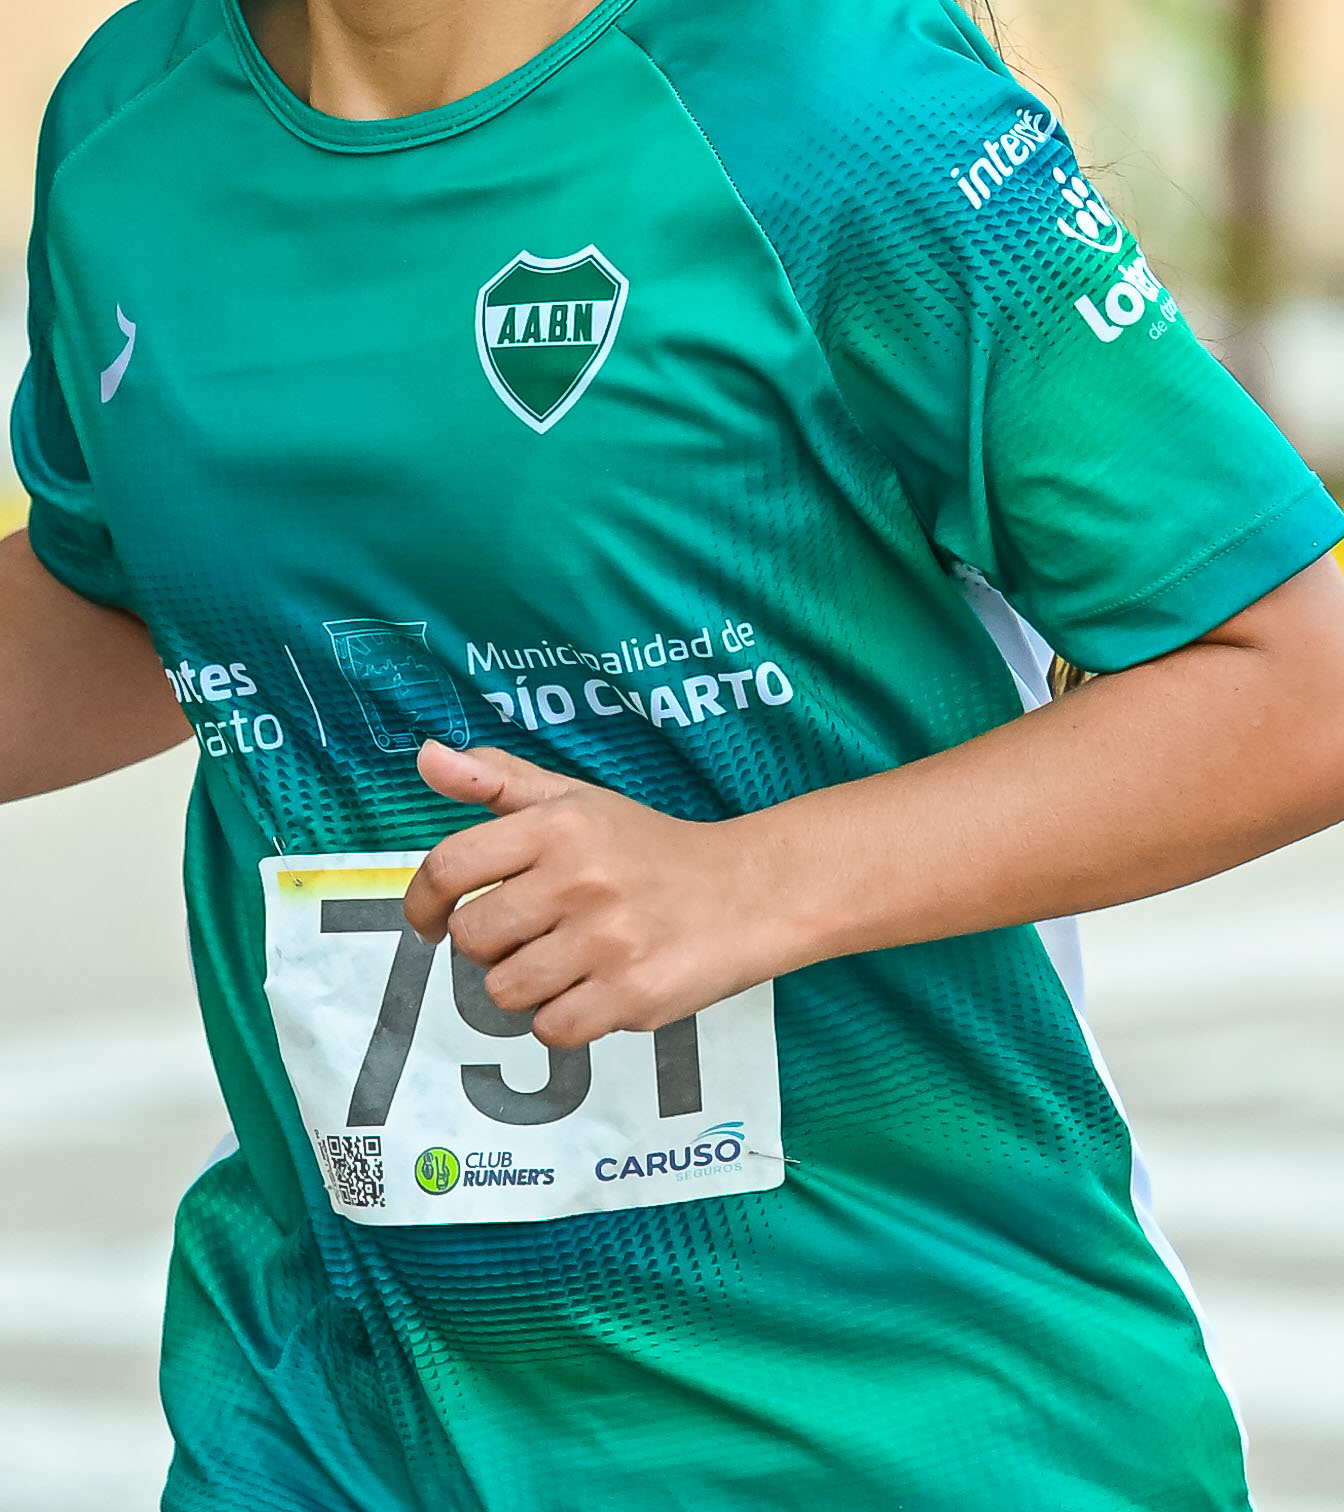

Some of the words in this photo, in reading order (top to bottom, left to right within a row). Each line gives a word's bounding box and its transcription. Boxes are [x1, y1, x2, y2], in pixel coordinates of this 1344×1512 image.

[1149, 320, 1168, 340] de
[721, 619, 755, 653] de
[465, 1151, 513, 1169] CLUB
[595, 1138, 742, 1182] CARUSO
[462, 1168, 556, 1187] RUNNER'S
[675, 1162, 743, 1182] SEGUROS
